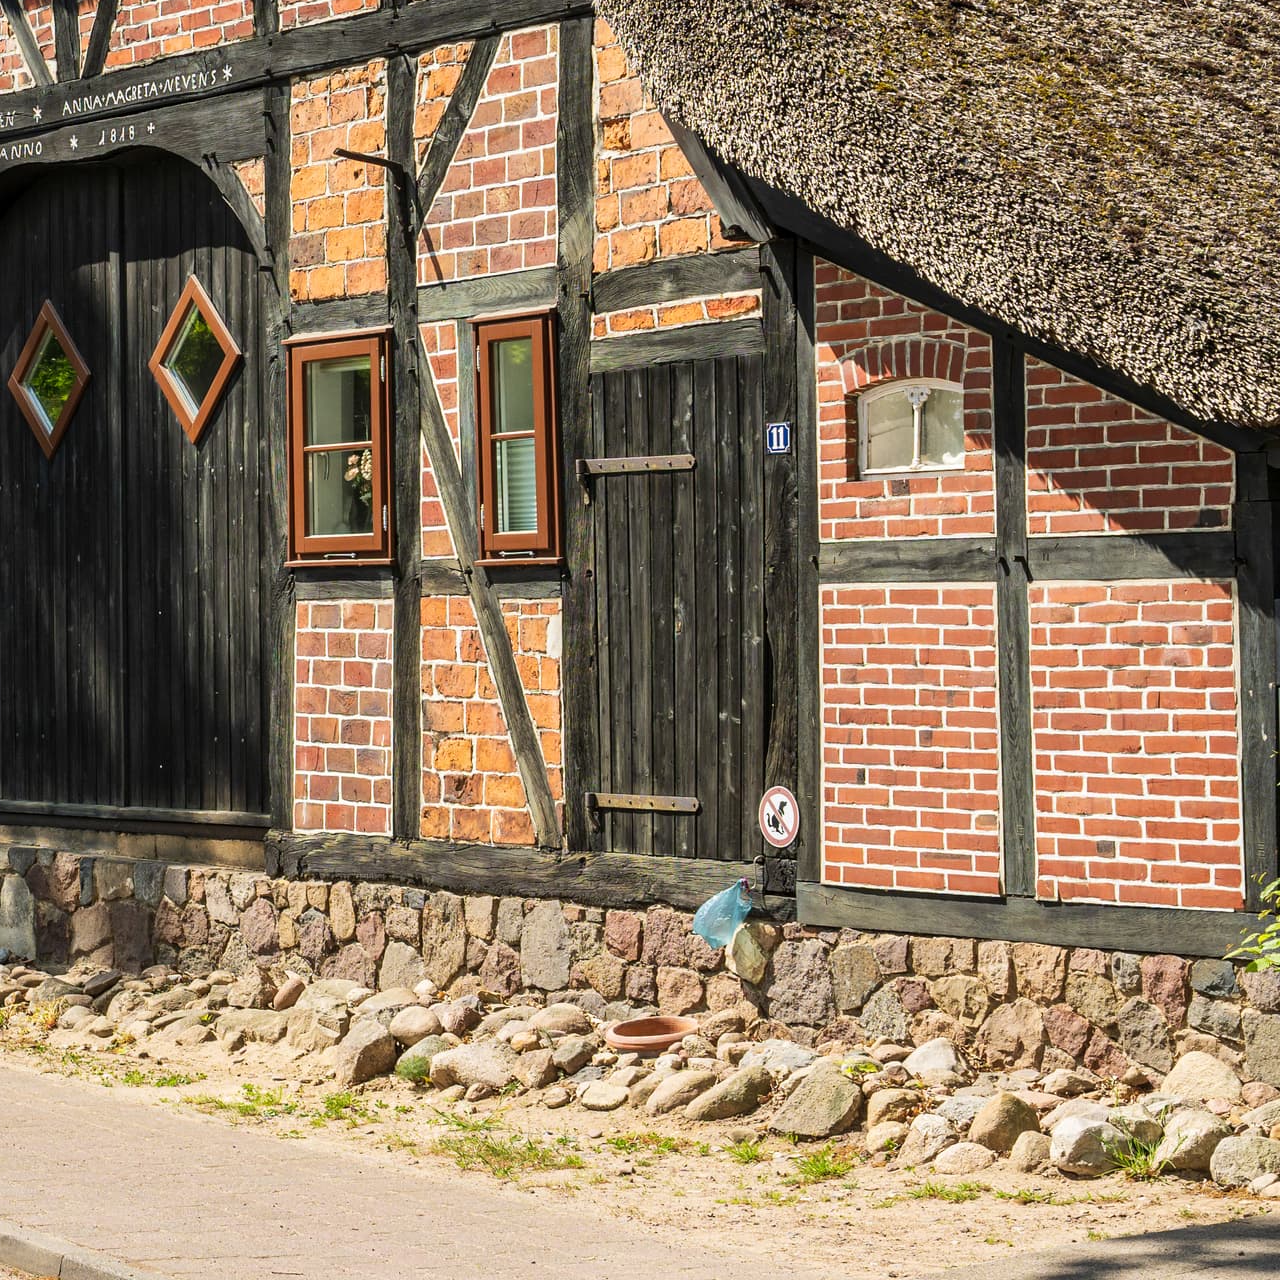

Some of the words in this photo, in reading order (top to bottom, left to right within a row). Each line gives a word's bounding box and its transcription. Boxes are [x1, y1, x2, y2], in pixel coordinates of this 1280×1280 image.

[62, 95, 104, 117] ANNA
[163, 69, 217, 93] NEVENS
[98, 125, 135, 146] 1818
[770, 426, 786, 450] 11
